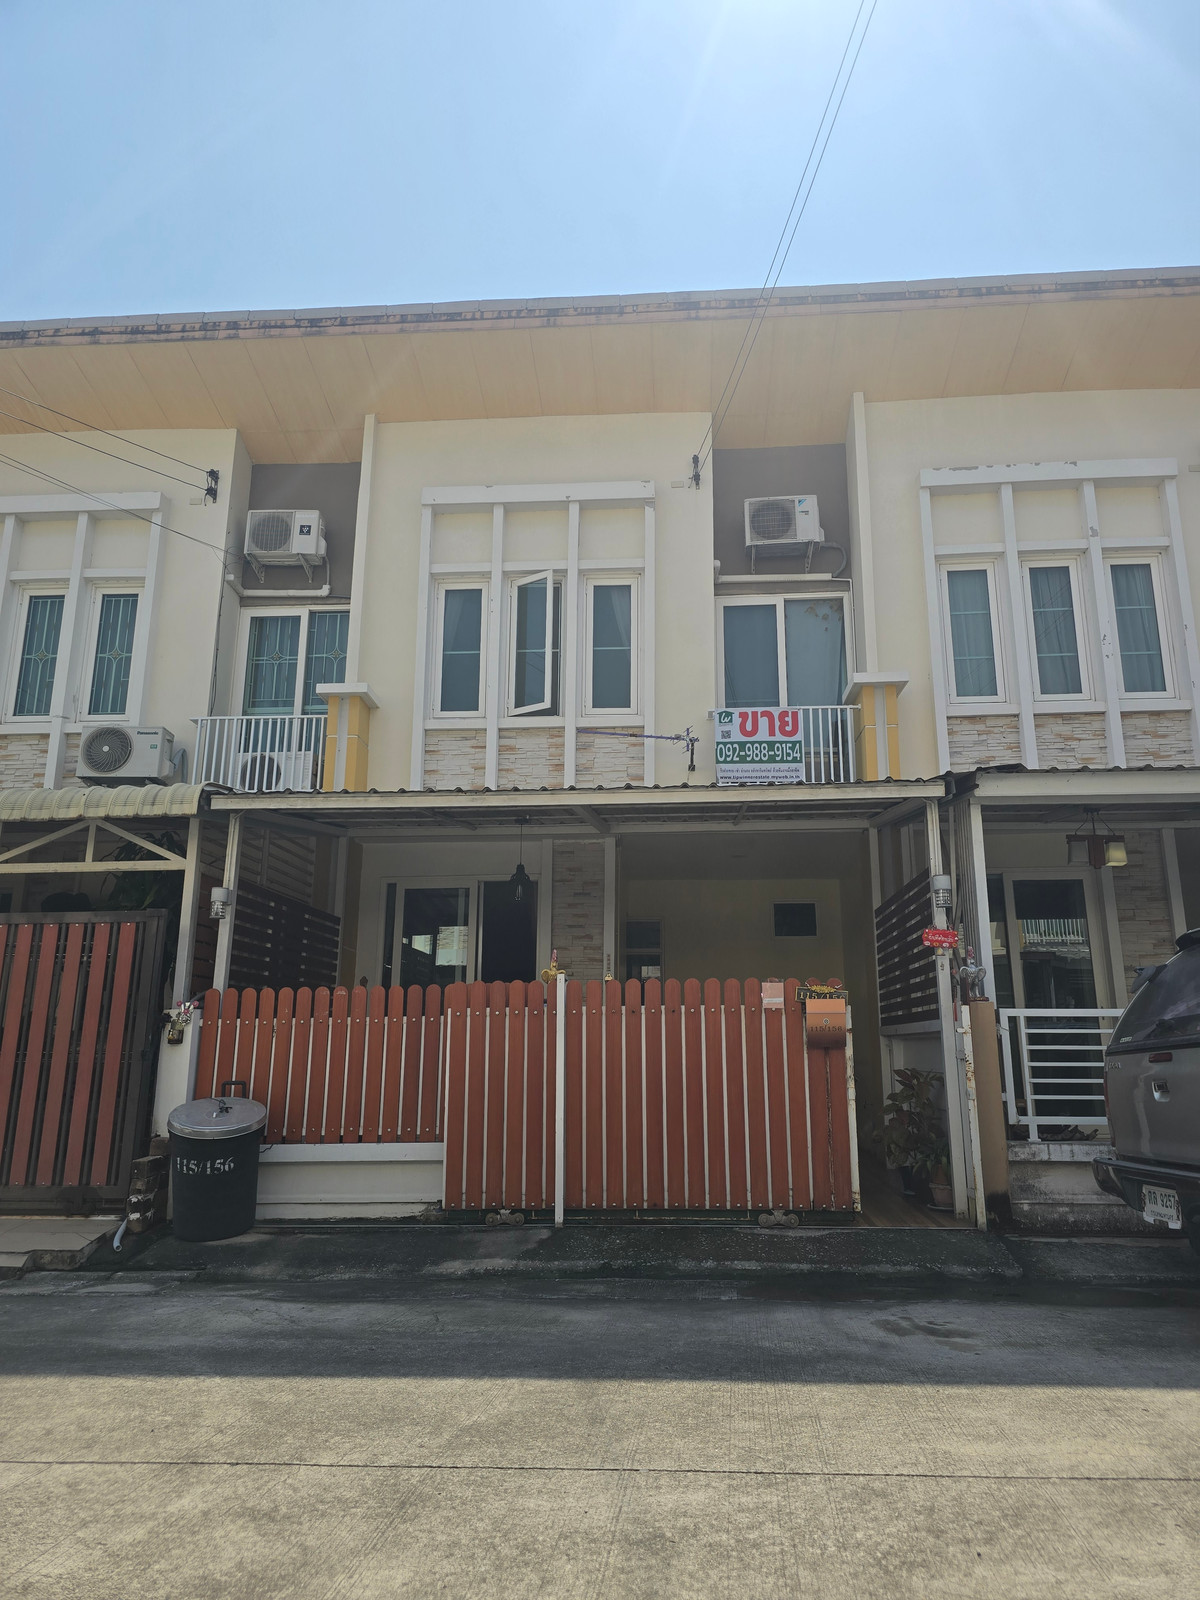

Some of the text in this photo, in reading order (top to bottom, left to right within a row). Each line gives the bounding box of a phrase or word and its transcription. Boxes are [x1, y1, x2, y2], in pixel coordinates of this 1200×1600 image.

[738, 710, 799, 738] ขาย
[716, 743, 801, 762] 092-988-9154
[810, 1024, 843, 1032] 115/156
[176, 1157, 234, 1175] 115/156
[1159, 1193, 1176, 1210] 9257
